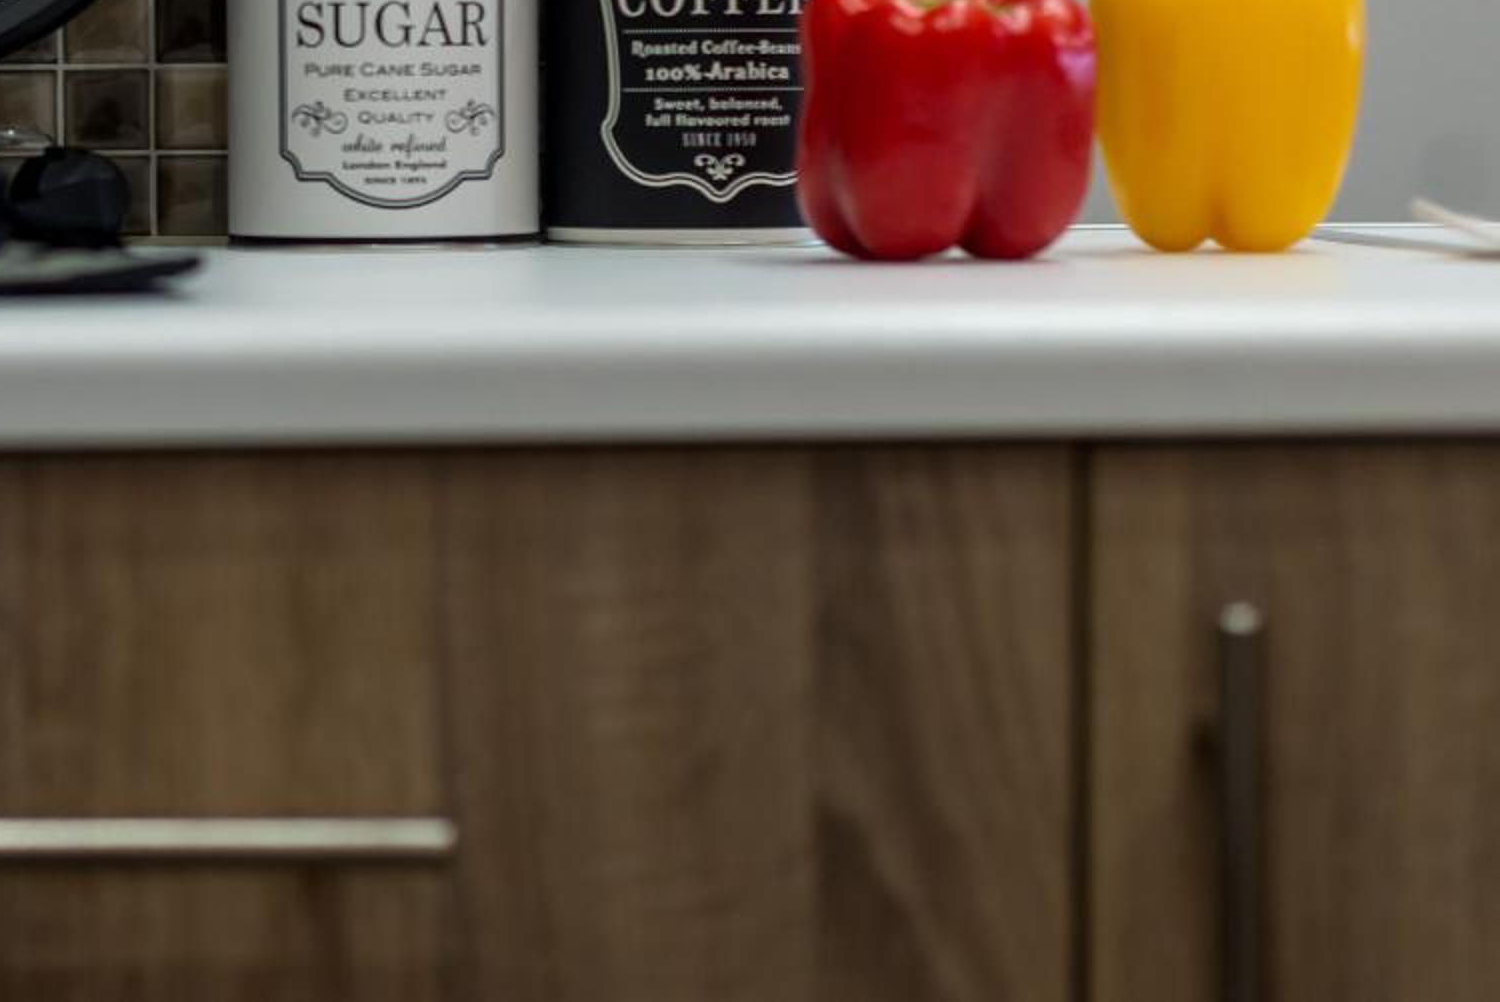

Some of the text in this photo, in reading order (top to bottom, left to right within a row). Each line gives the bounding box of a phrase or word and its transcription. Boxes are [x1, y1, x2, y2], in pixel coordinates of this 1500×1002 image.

[296, 0, 489, 48] SUGAR
[631, 40, 698, 58] Roasted
[304, 62, 483, 78] PURE CANE SUGAR
[343, 88, 447, 103] EXCELLENT
[654, 98, 704, 112] Sweet,
[357, 110, 435, 126] QUALITY
